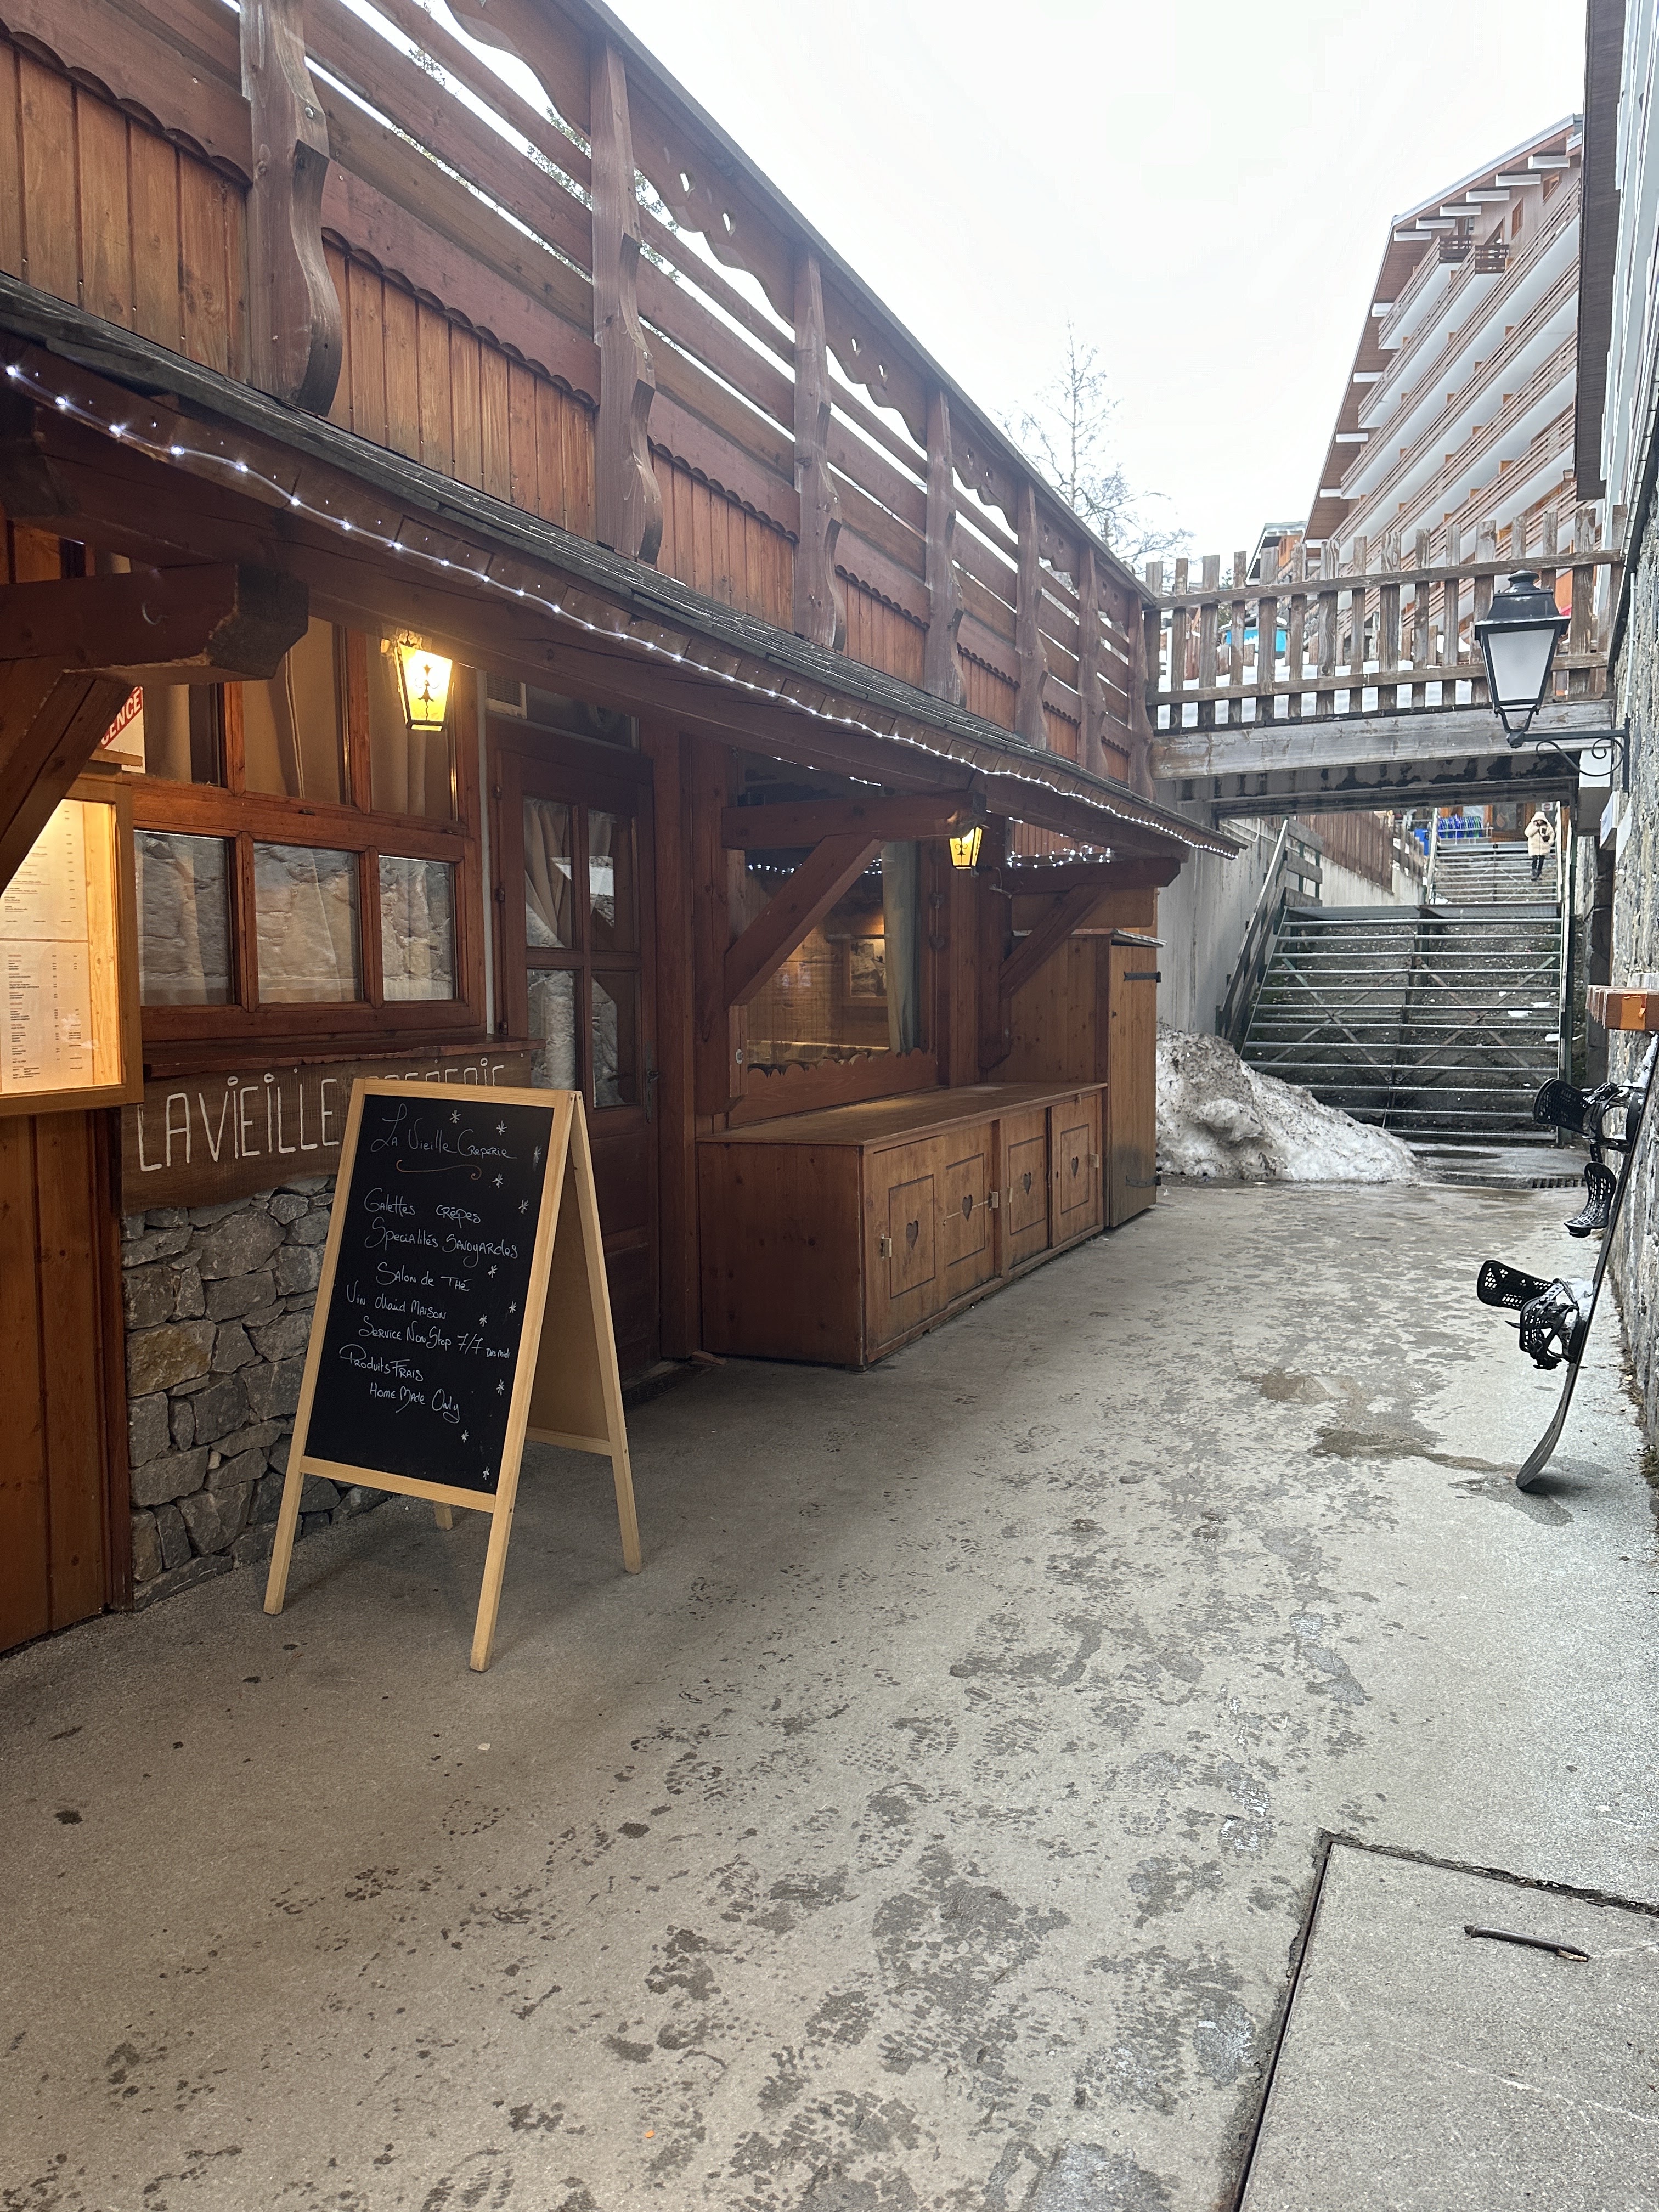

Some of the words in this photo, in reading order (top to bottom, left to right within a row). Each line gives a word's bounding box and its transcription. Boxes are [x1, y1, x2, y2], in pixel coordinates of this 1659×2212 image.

[408, 1118, 458, 1153] Vieille
[421, 1271, 435, 1286] de
[457, 1333, 483, 1355] 7/7
